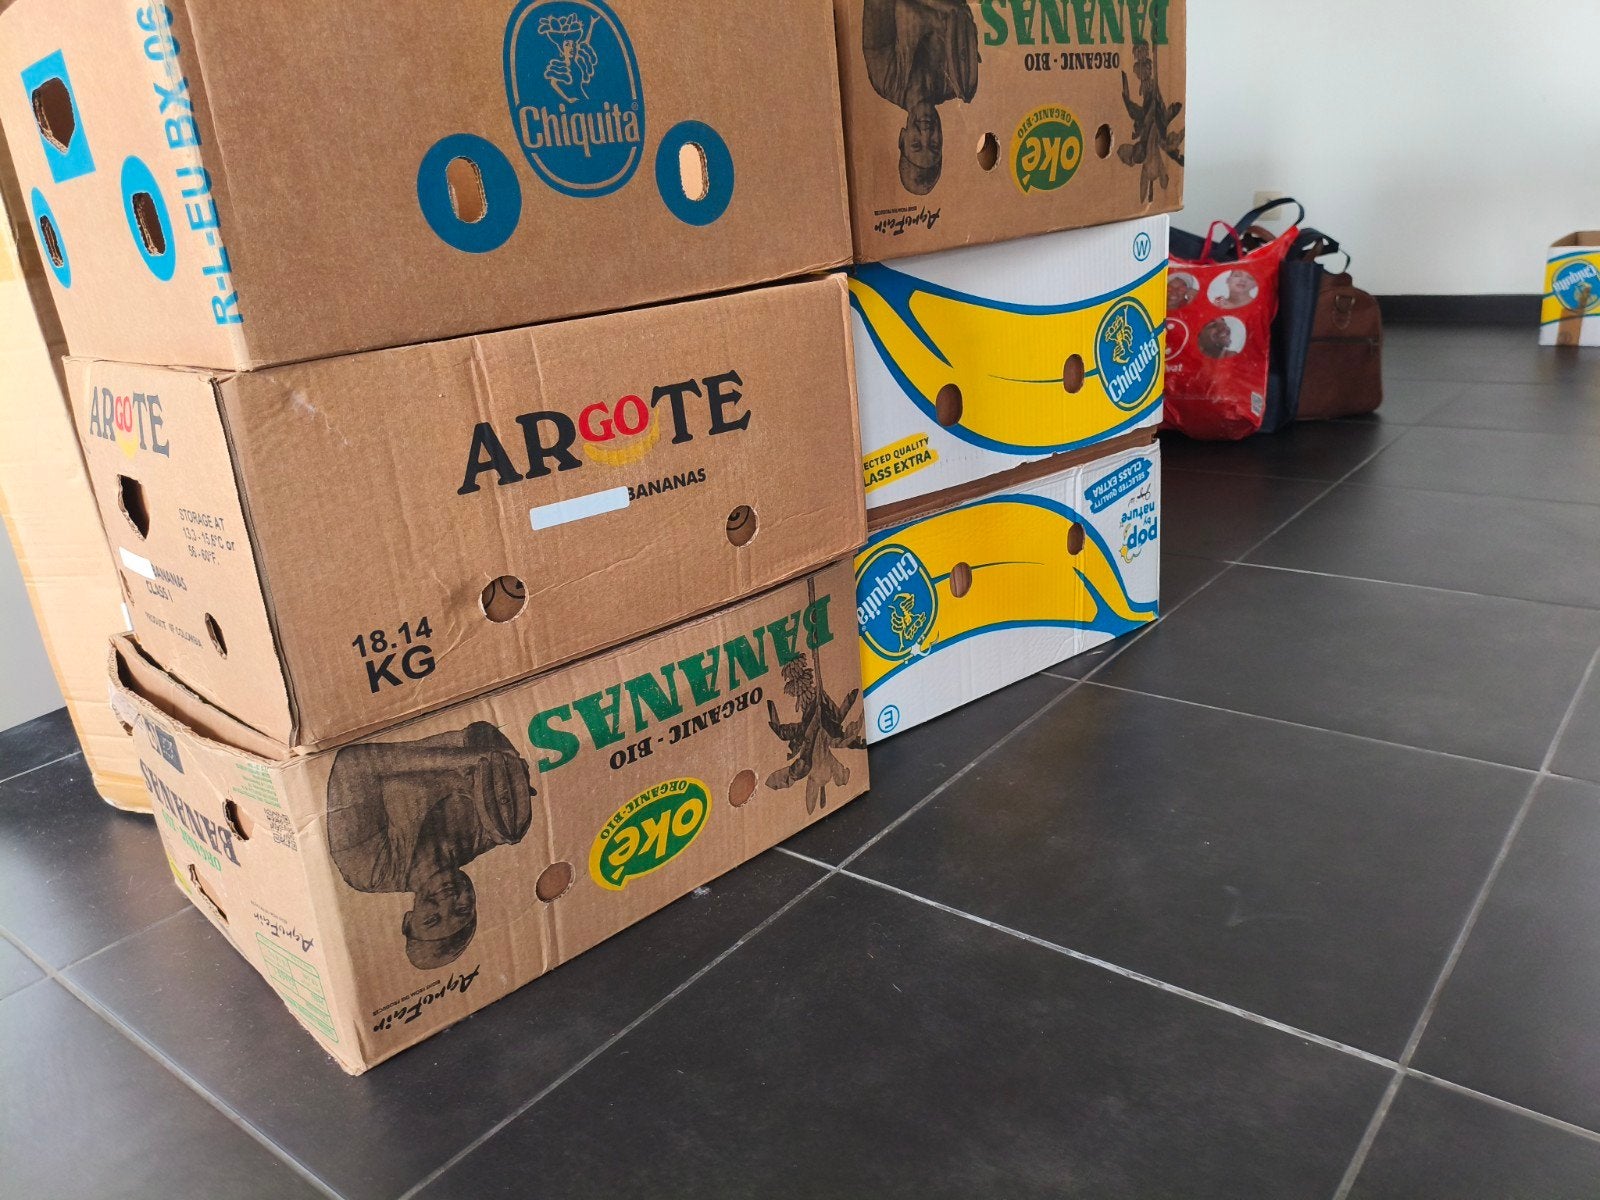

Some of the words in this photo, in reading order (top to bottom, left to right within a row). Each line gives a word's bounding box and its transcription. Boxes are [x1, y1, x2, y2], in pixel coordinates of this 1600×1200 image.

[981, 0, 1169, 46] BANANAS
[1024, 53, 1051, 71] BIO
[1061, 52, 1120, 70] ORGANIC
[518, 101, 641, 158] Chiquita
[176, 165, 244, 326] R-L-EU
[1107, 332, 1160, 403] Chiquita
[89, 386, 170, 459] ARGOTE
[457, 369, 752, 496] ARGOTE
[862, 452, 893, 472] ECTED
[893, 436, 930, 459] QUALITY
[863, 465, 892, 488] LASS
[893, 449, 932, 475] EXTRA
[1118, 462, 1142, 481] CLASS
[627, 467, 707, 502] BANANAS
[1092, 476, 1118, 498] EXTRA
[179, 508, 213, 528] STORAGE
[214, 516, 225, 531] AT
[1121, 501, 1155, 523] nature
[1127, 516, 1158, 549] pop
[856, 552, 919, 625] Chiquita
[352, 616, 433, 658] 18.14
[366, 644, 436, 694] KG
[527, 594, 835, 774] BANANAS
[668, 686, 764, 746] ORGANIC
[609, 737, 653, 771] BIO
[140, 758, 242, 867] BANANAS
